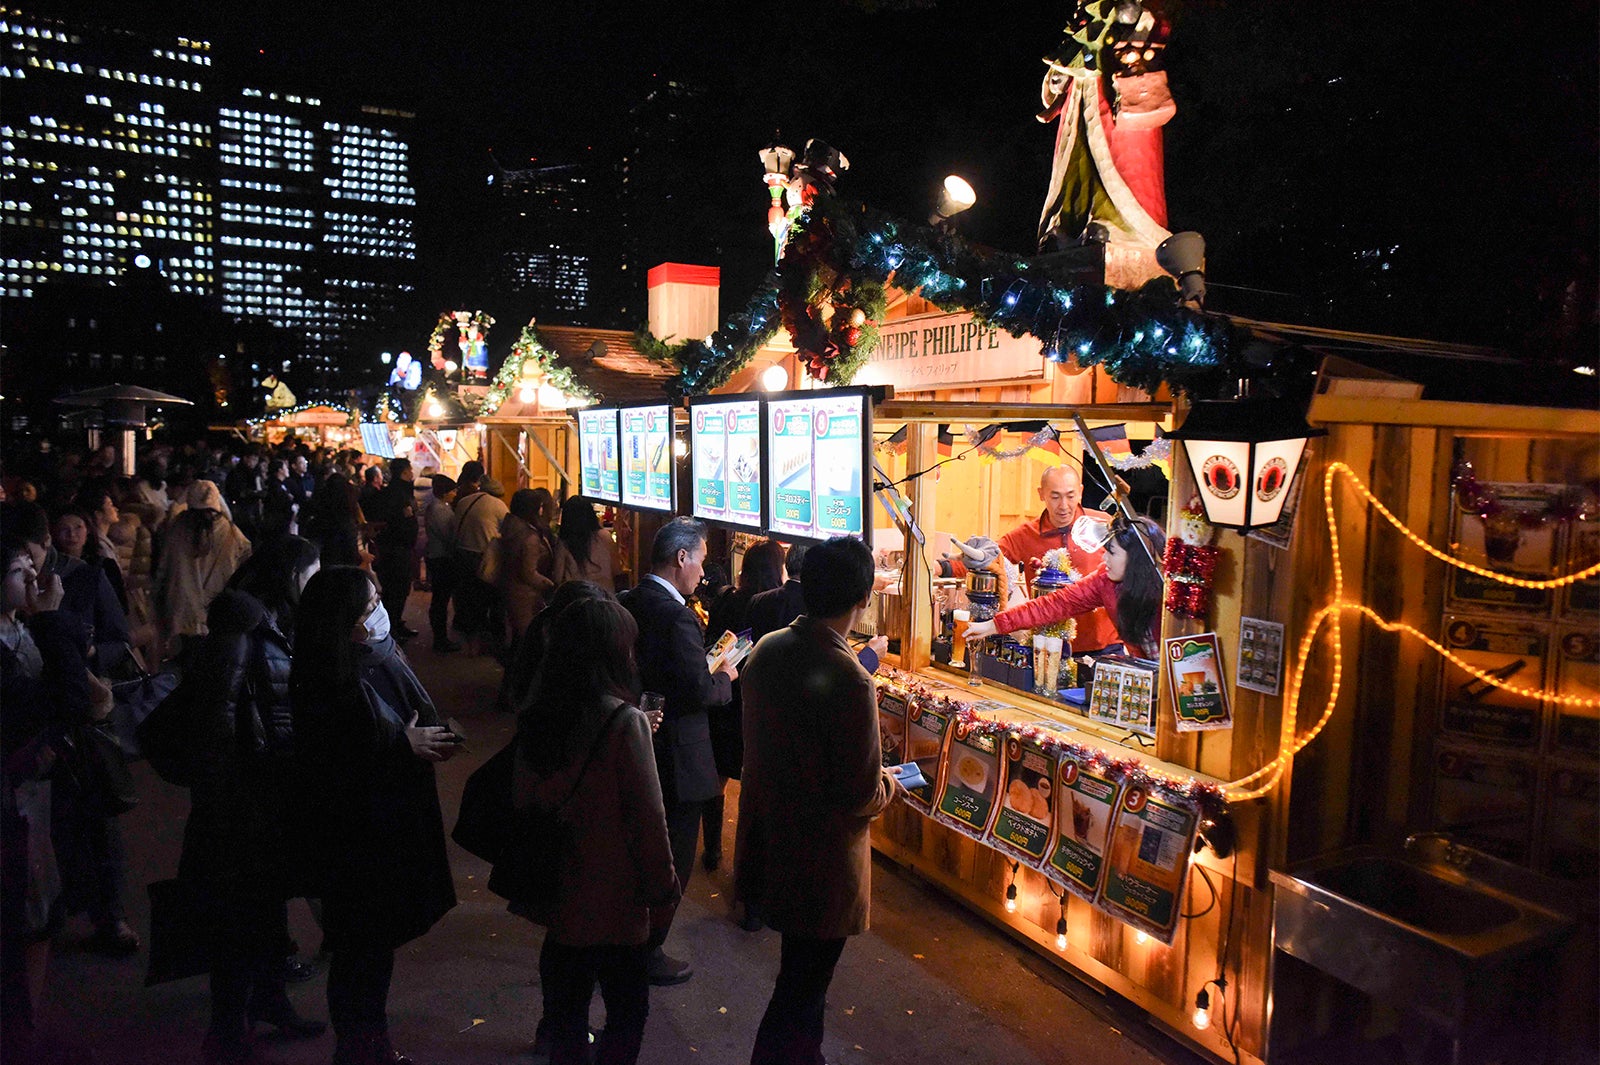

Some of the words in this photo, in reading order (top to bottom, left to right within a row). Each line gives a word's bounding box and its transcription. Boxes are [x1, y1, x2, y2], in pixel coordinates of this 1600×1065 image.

[869, 330, 918, 361] NEIPE
[922, 322, 999, 356] PHILIPPE
[776, 412, 782, 427] 7
[818, 414, 824, 428] 8
[1171, 646, 1181, 658] 11
[957, 723, 965, 734] 8
[1010, 744, 1018, 756] 9
[1066, 764, 1074, 779] 1
[953, 796, 979, 812] コーンスープ
[1128, 790, 1140, 807] 3
